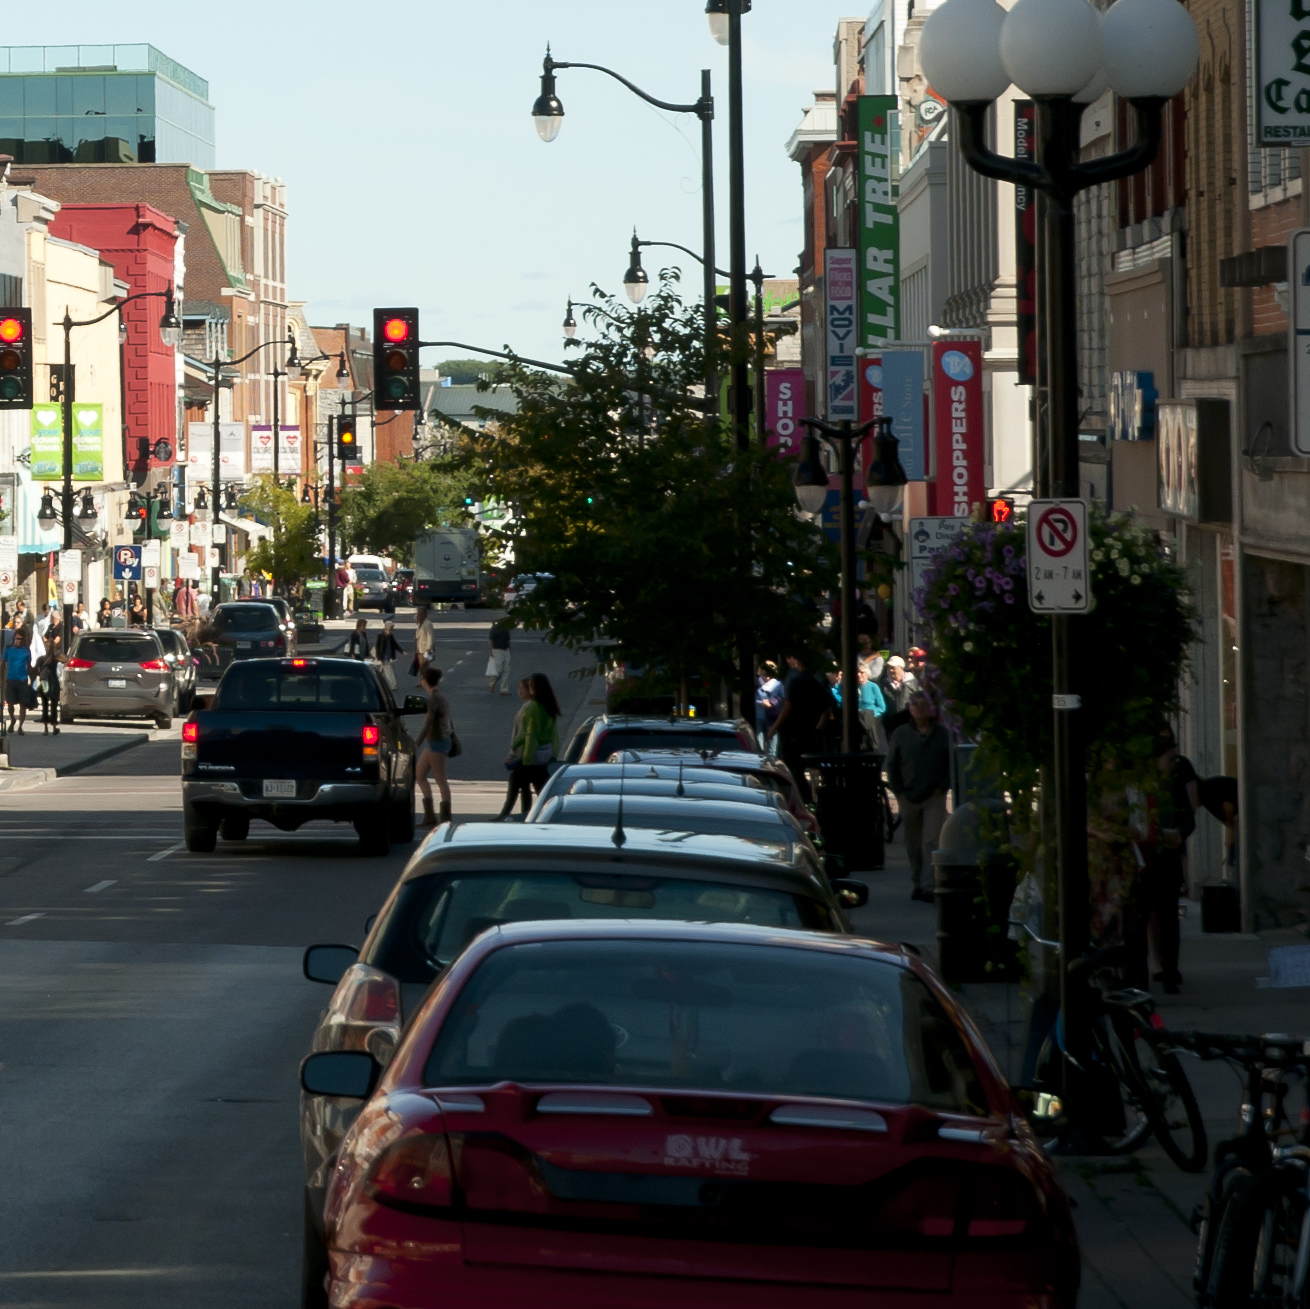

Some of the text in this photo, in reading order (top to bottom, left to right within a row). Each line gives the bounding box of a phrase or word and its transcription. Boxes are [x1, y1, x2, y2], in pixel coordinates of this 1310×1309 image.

[1016, 118, 1029, 158] Model
[865, 130, 896, 351] LLAR TREE
[34, 444, 60, 452] town
[76, 444, 102, 452] town
[950, 385, 970, 517] SHOPPERS
[1034, 566, 1041, 581] 2
[1043, 569, 1054, 580] AM
[1062, 566, 1068, 580] 7
